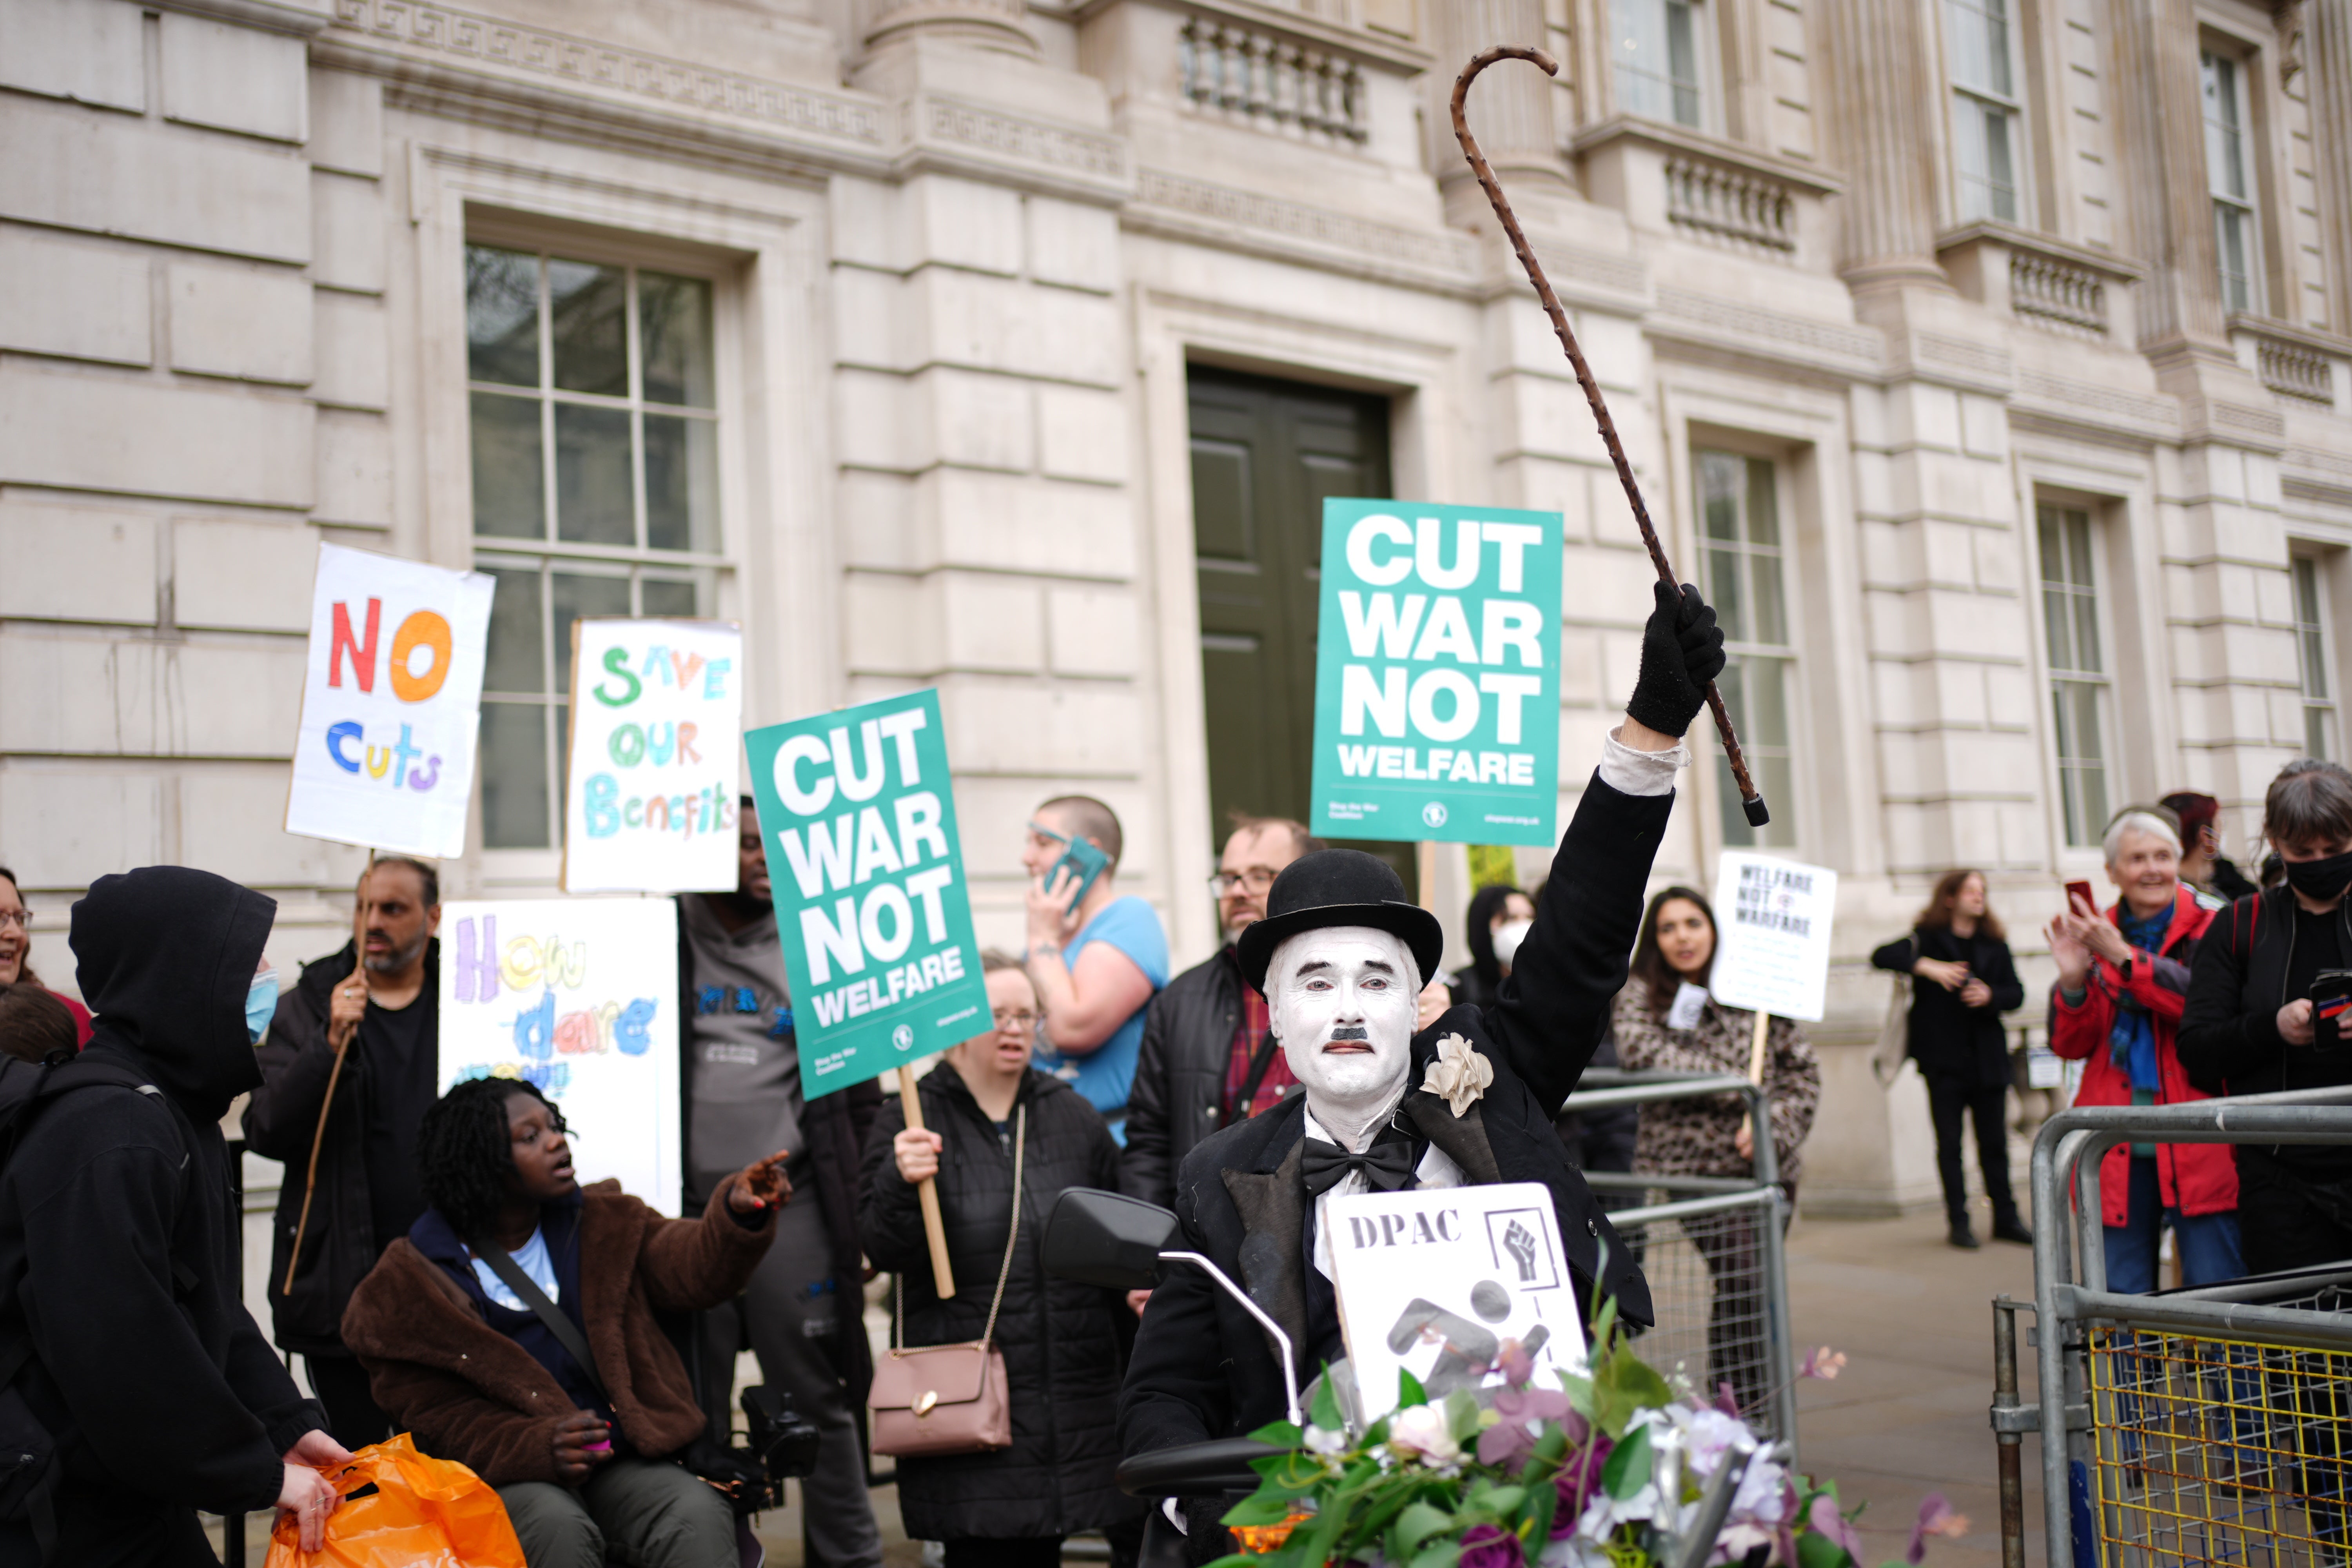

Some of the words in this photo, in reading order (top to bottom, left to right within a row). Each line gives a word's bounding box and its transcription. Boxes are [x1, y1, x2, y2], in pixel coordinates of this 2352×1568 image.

[1346, 514, 1543, 593] CUT
[328, 597, 452, 702] NO
[1338, 590, 1543, 668] WAR
[592, 646, 731, 708] SAVE
[1340, 664, 1541, 744] NOT
[327, 720, 442, 790] Cuts
[608, 721, 702, 768] OUR
[773, 707, 927, 816] CUT
[1337, 744, 1535, 786] WELFARE
[584, 773, 737, 840] Benefits
[779, 791, 948, 899] WAR
[1741, 864, 1813, 895] WELFARE
[800, 864, 953, 986] NOT
[1735, 907, 1811, 938] WARFARE
[1737, 886, 1770, 904] NOT
[455, 914, 586, 1004] How
[811, 946, 965, 1027] WELFARE
[513, 988, 659, 1062] dare
[1348, 1208, 1462, 1249] DPAC
